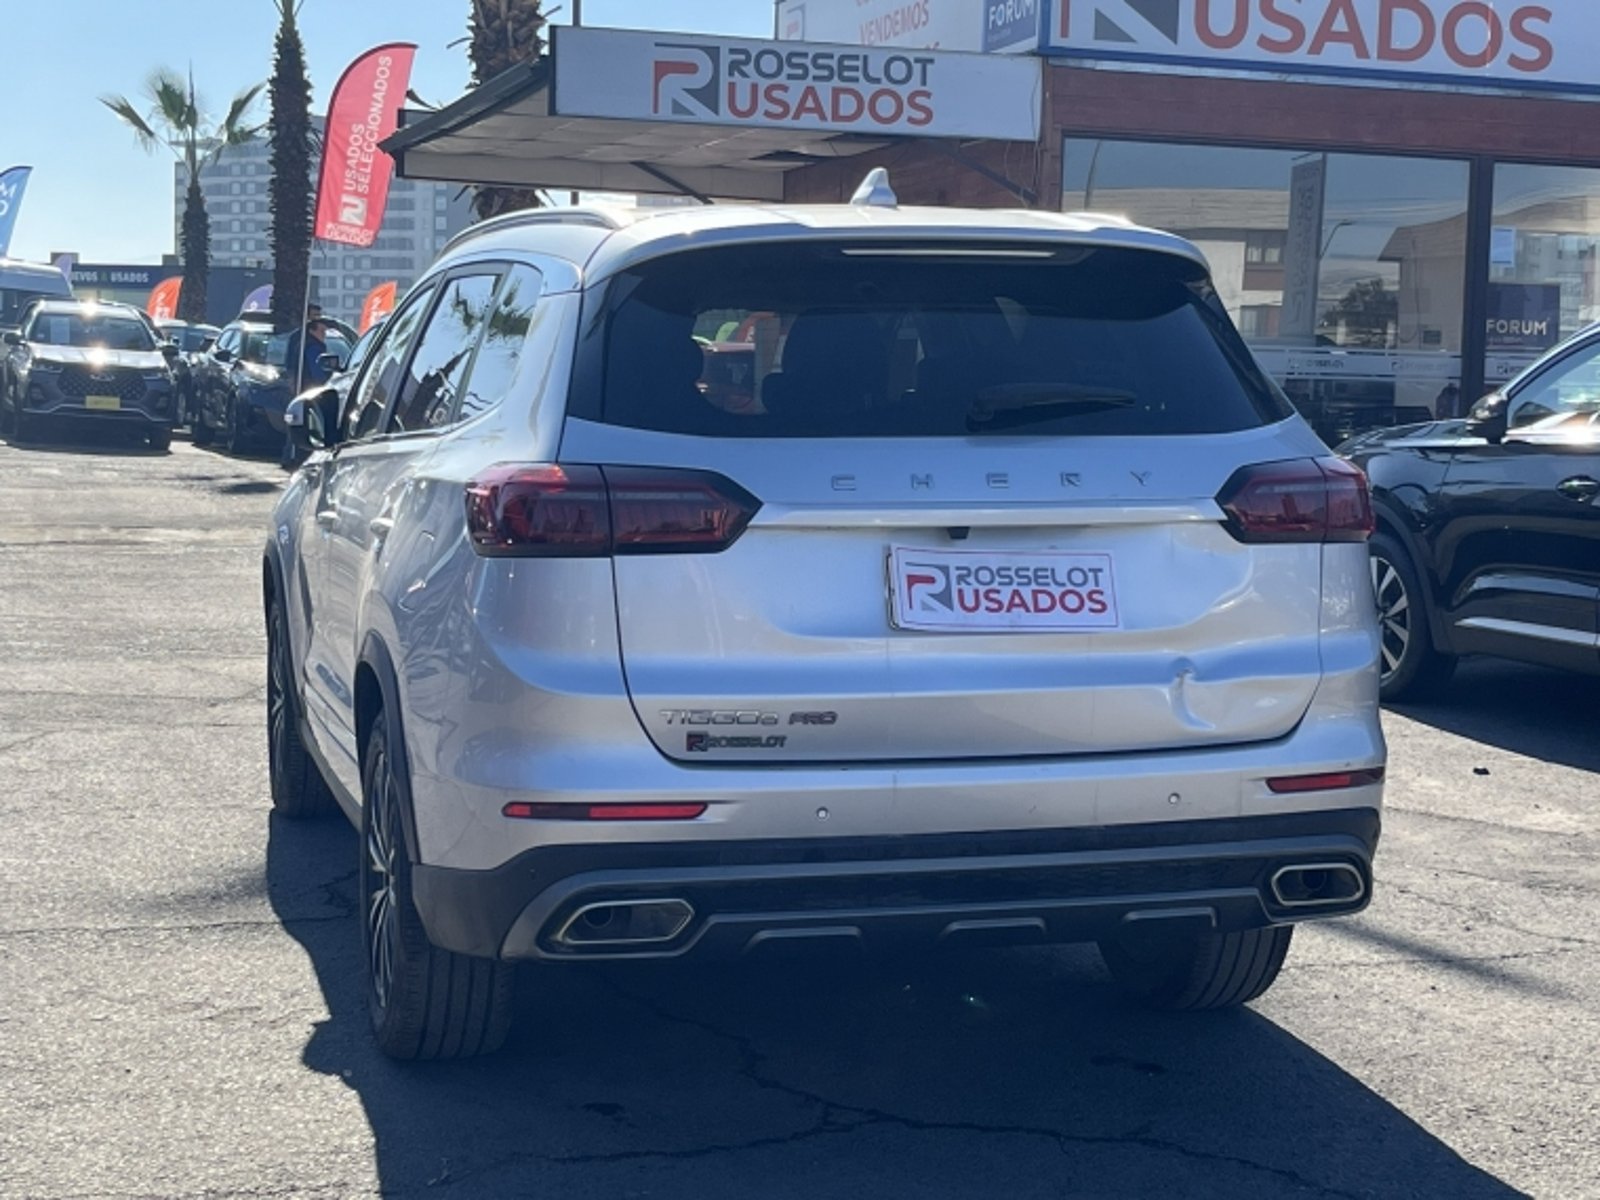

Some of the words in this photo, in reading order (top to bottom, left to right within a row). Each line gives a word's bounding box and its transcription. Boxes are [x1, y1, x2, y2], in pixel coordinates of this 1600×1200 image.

[860, 2, 930, 47] VENDEMOS
[1193, 0, 1555, 73] USADOS
[728, 48, 935, 86] ROSSELOT
[728, 81, 934, 126] USADOS
[357, 56, 392, 194] SELECCIONADOS
[344, 123, 365, 191] USADOS
[1485, 319, 1547, 336] FORUM
[830, 470, 1151, 491] CHERY
[955, 566, 1104, 587] ROSSELOT
[957, 588, 1108, 613] USADOS
[788, 710, 839, 725] PRO
